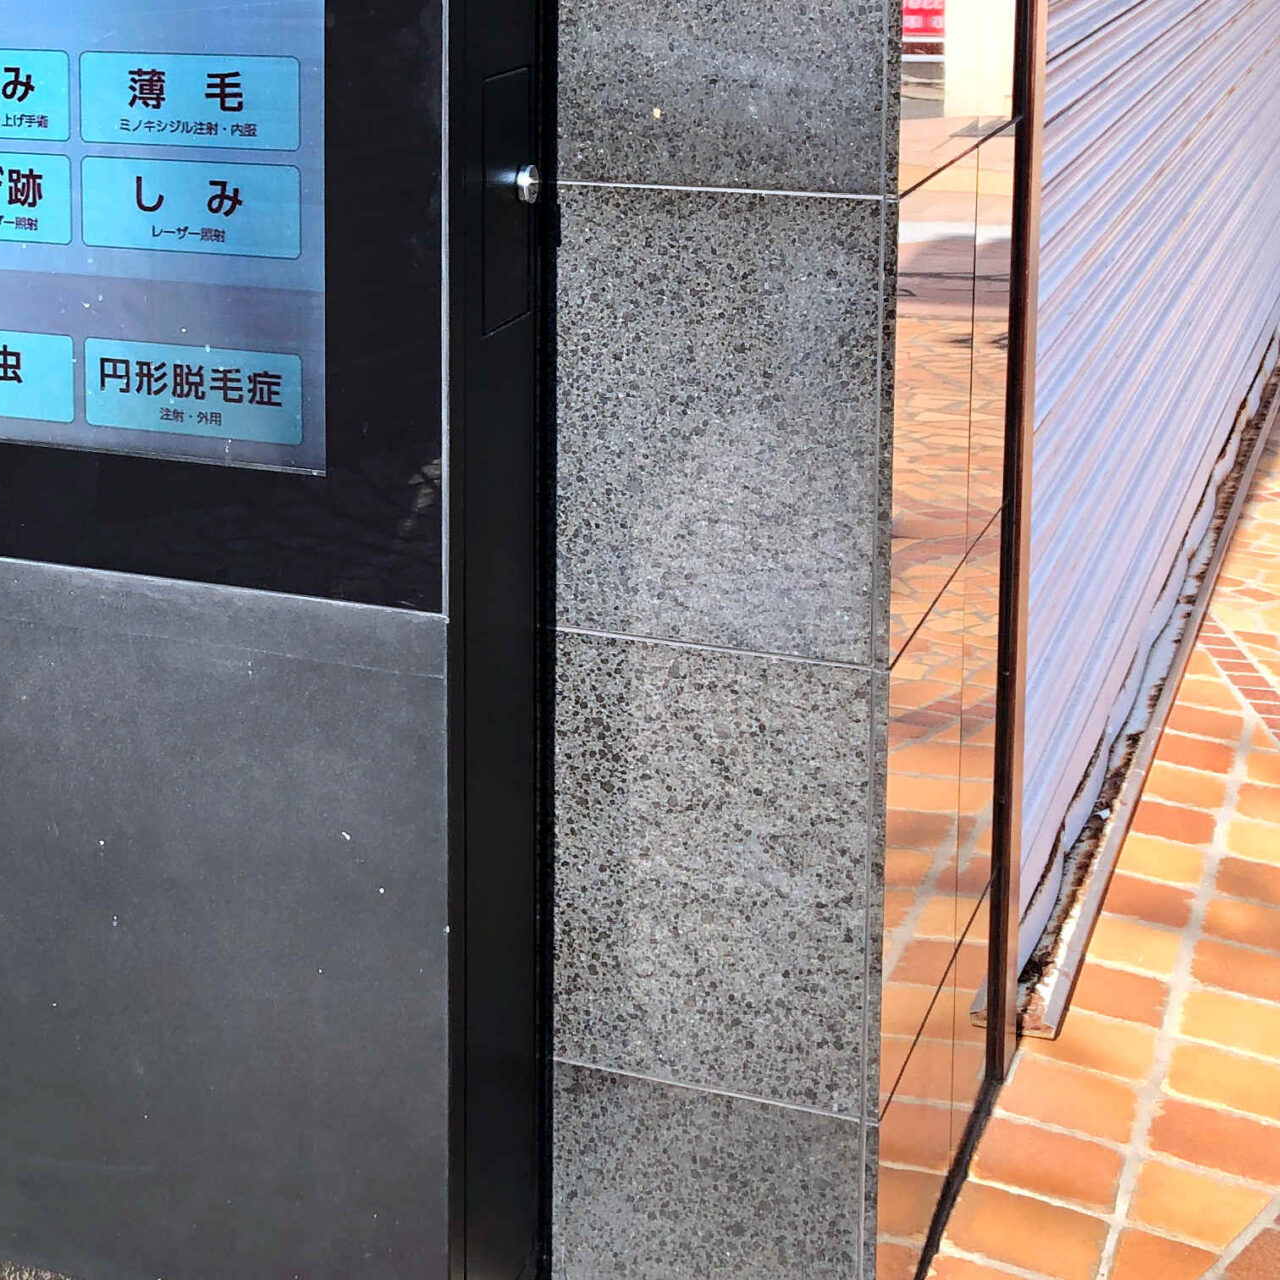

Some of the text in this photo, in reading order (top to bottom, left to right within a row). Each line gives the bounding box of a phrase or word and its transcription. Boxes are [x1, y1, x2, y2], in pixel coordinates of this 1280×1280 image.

[151, 224, 227, 244] レーザー照射
[98, 355, 284, 408] 円形脱毛症
[158, 406, 223, 427] 注射・外用
